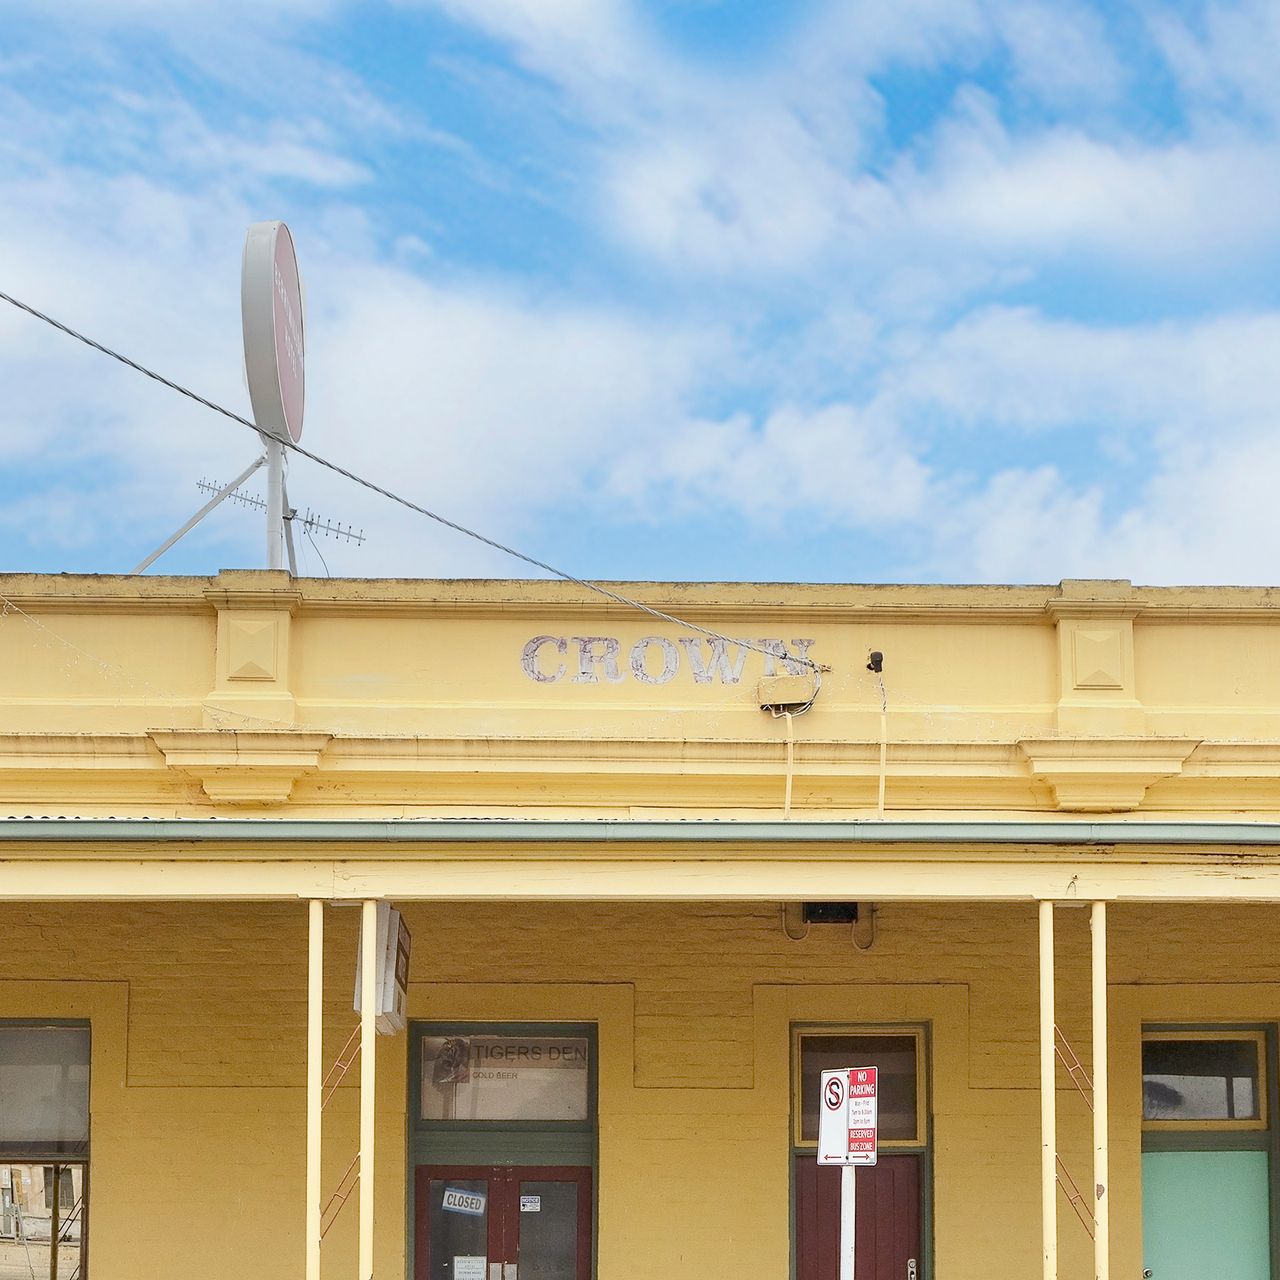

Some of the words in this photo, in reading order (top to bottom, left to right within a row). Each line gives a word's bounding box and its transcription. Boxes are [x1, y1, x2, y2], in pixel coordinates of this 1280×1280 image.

[521, 635, 816, 684] CROWN
[472, 1045, 541, 1061] TIGERS
[549, 1046, 587, 1061] DEN
[473, 1071, 495, 1079] COLD
[496, 1071, 518, 1079] BEER
[858, 1072, 867, 1082] NO
[850, 1083, 875, 1096] PARKING
[850, 1130, 874, 1139] RESERVED
[850, 1142, 860, 1151] BUS
[860, 1142, 873, 1151] ZONE
[447, 1194, 482, 1210] CLOSED
